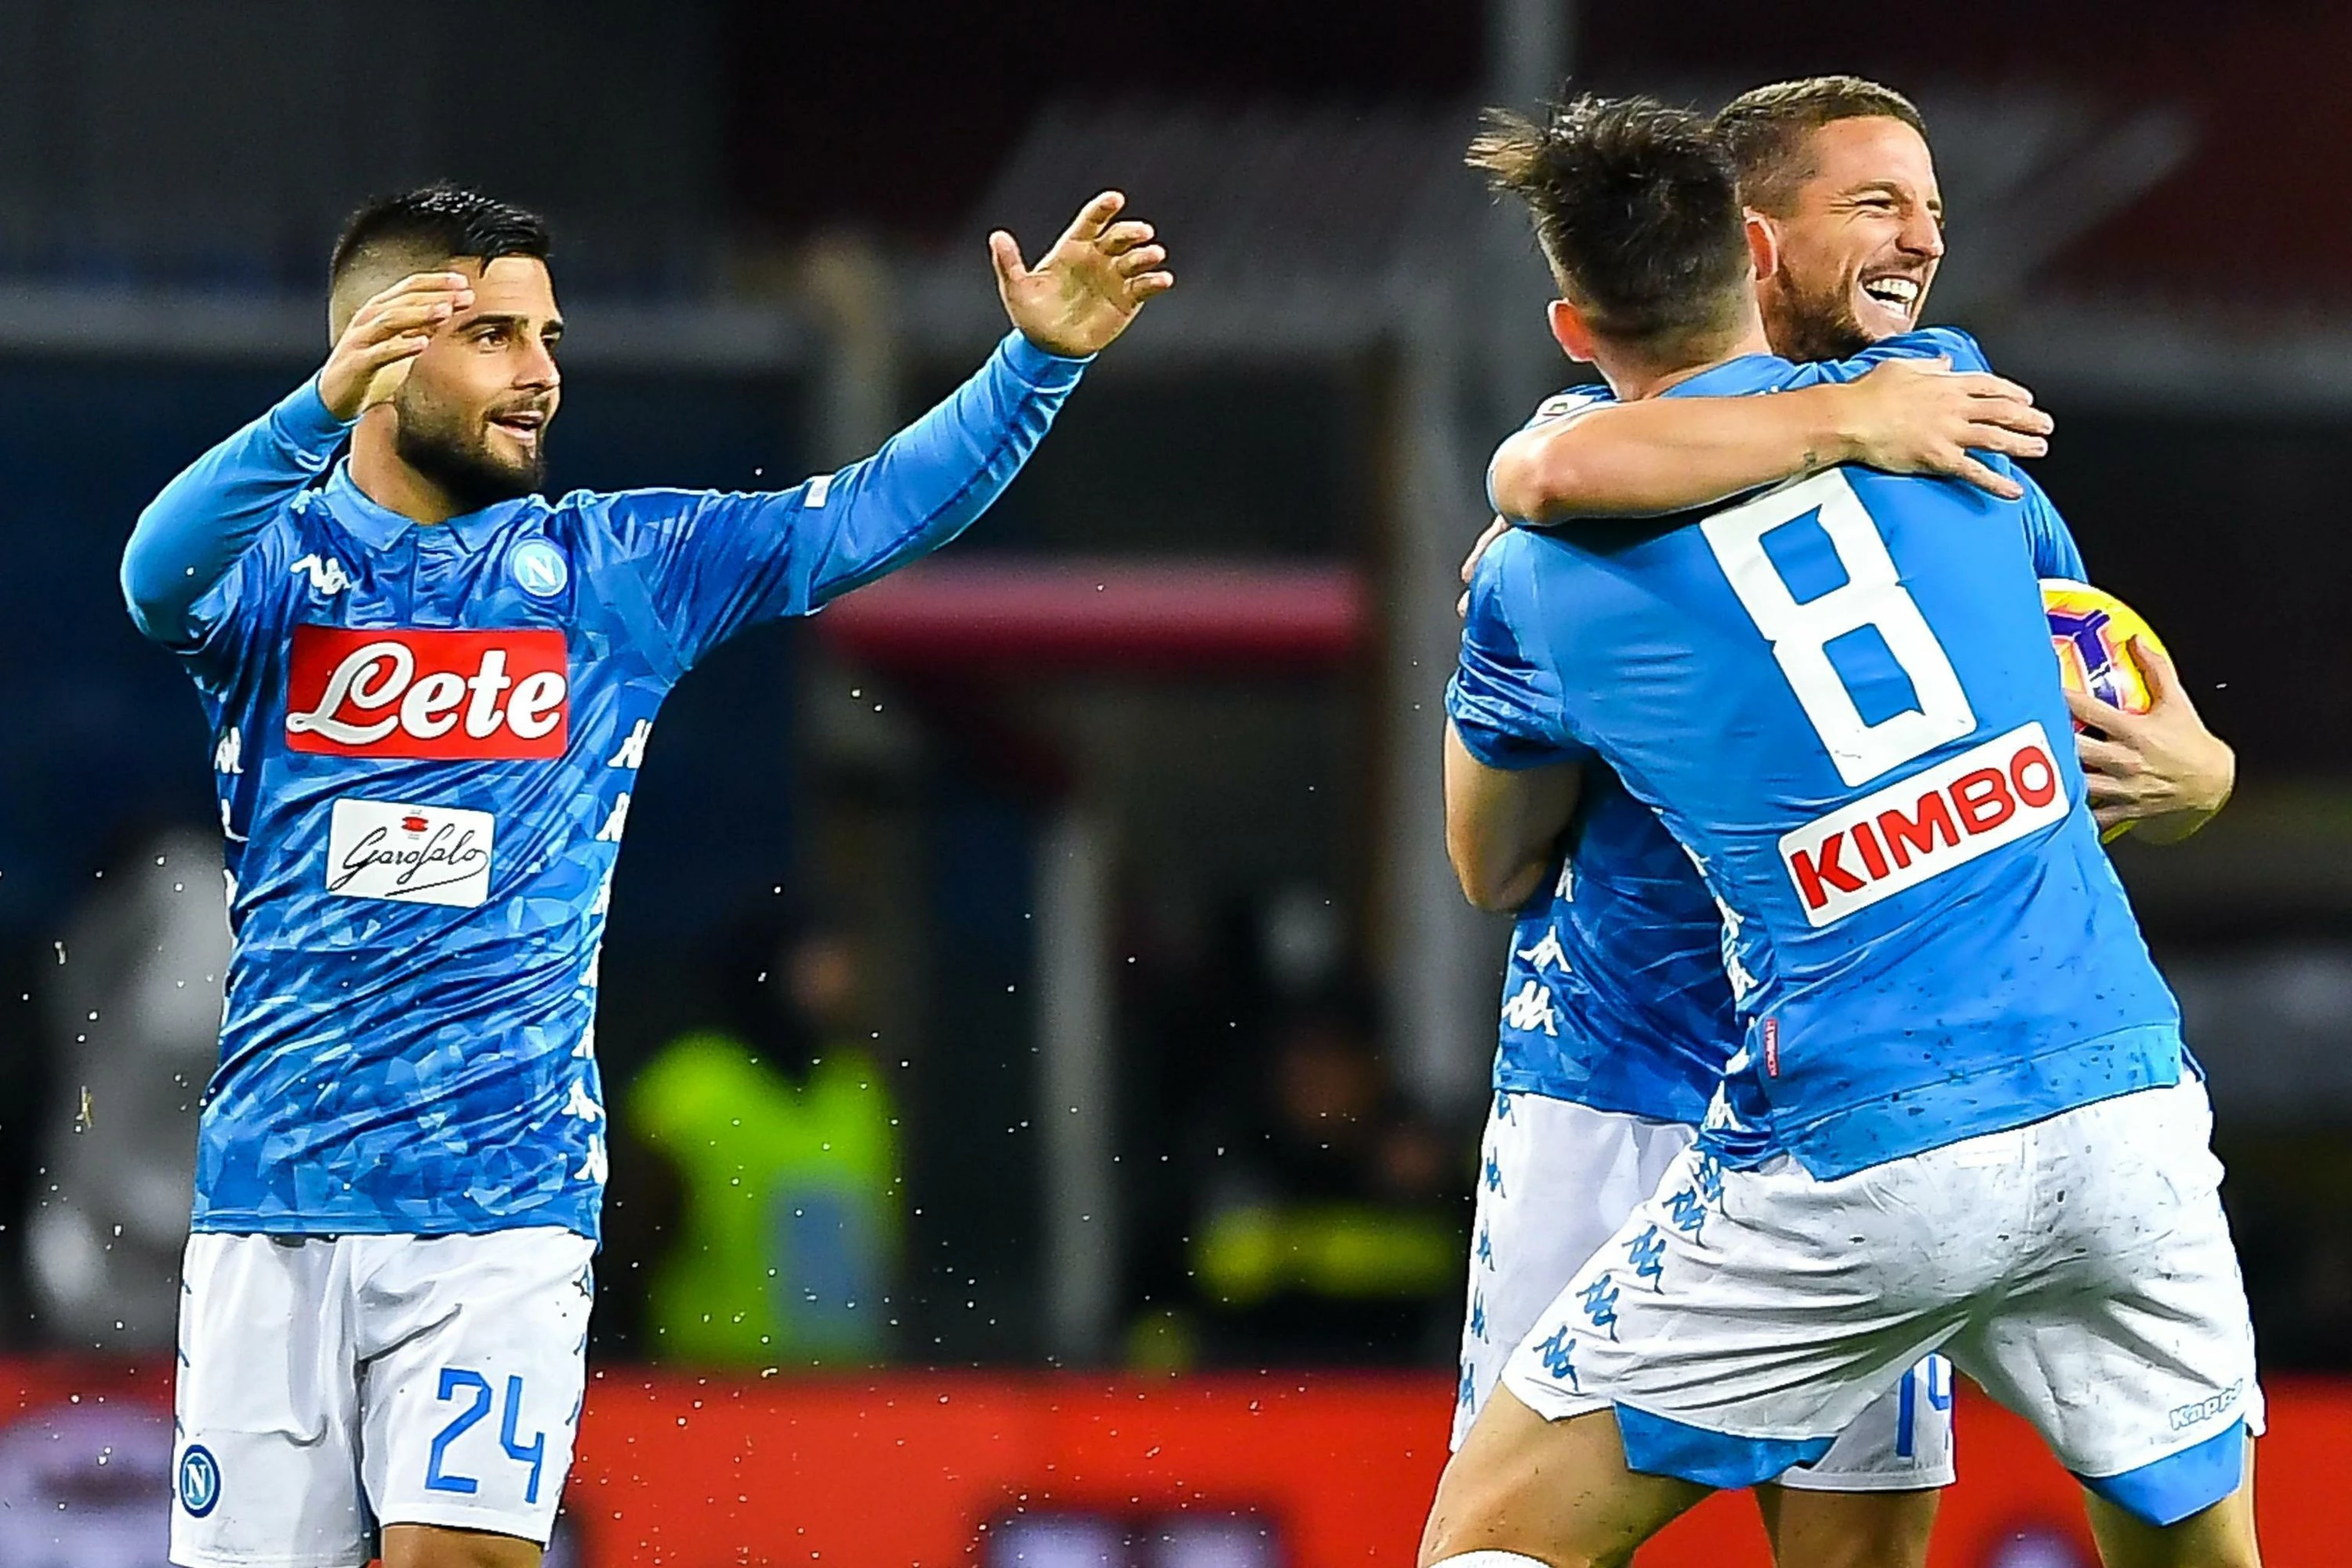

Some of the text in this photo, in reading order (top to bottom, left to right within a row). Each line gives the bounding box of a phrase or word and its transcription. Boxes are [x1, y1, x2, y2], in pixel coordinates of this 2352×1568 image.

[525, 555, 557, 587] N
[1700, 467, 1977, 787] 8
[285, 641, 568, 746] Lete
[329, 823, 489, 897] Garofalo
[1790, 745, 2054, 910] KIMBO
[187, 1463, 206, 1498] N
[426, 1367, 546, 1504] 24
